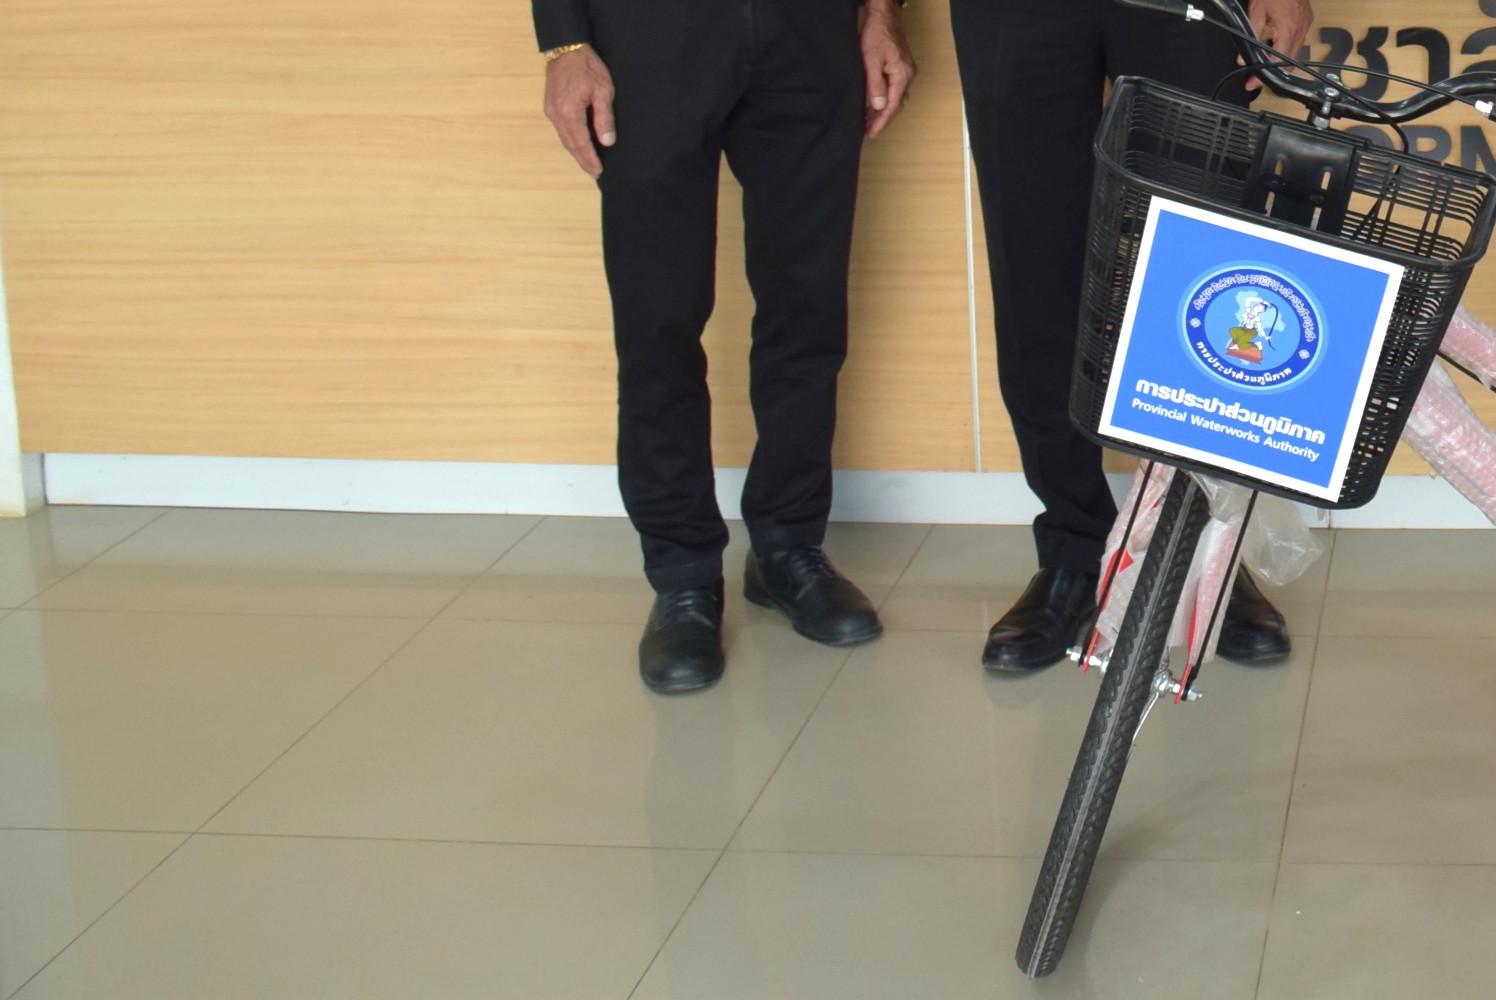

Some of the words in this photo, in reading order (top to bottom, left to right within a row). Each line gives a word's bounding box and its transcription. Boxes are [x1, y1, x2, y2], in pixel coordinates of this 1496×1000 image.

[1195, 340, 1293, 385] การประปาส่วนภูมิภาค
[1131, 398, 1187, 423] Provincial
[1190, 413, 1260, 446] Waterworks
[1263, 436, 1321, 463] Authority
[1135, 379, 1326, 445] การประปาส่วนภูมิภาค
